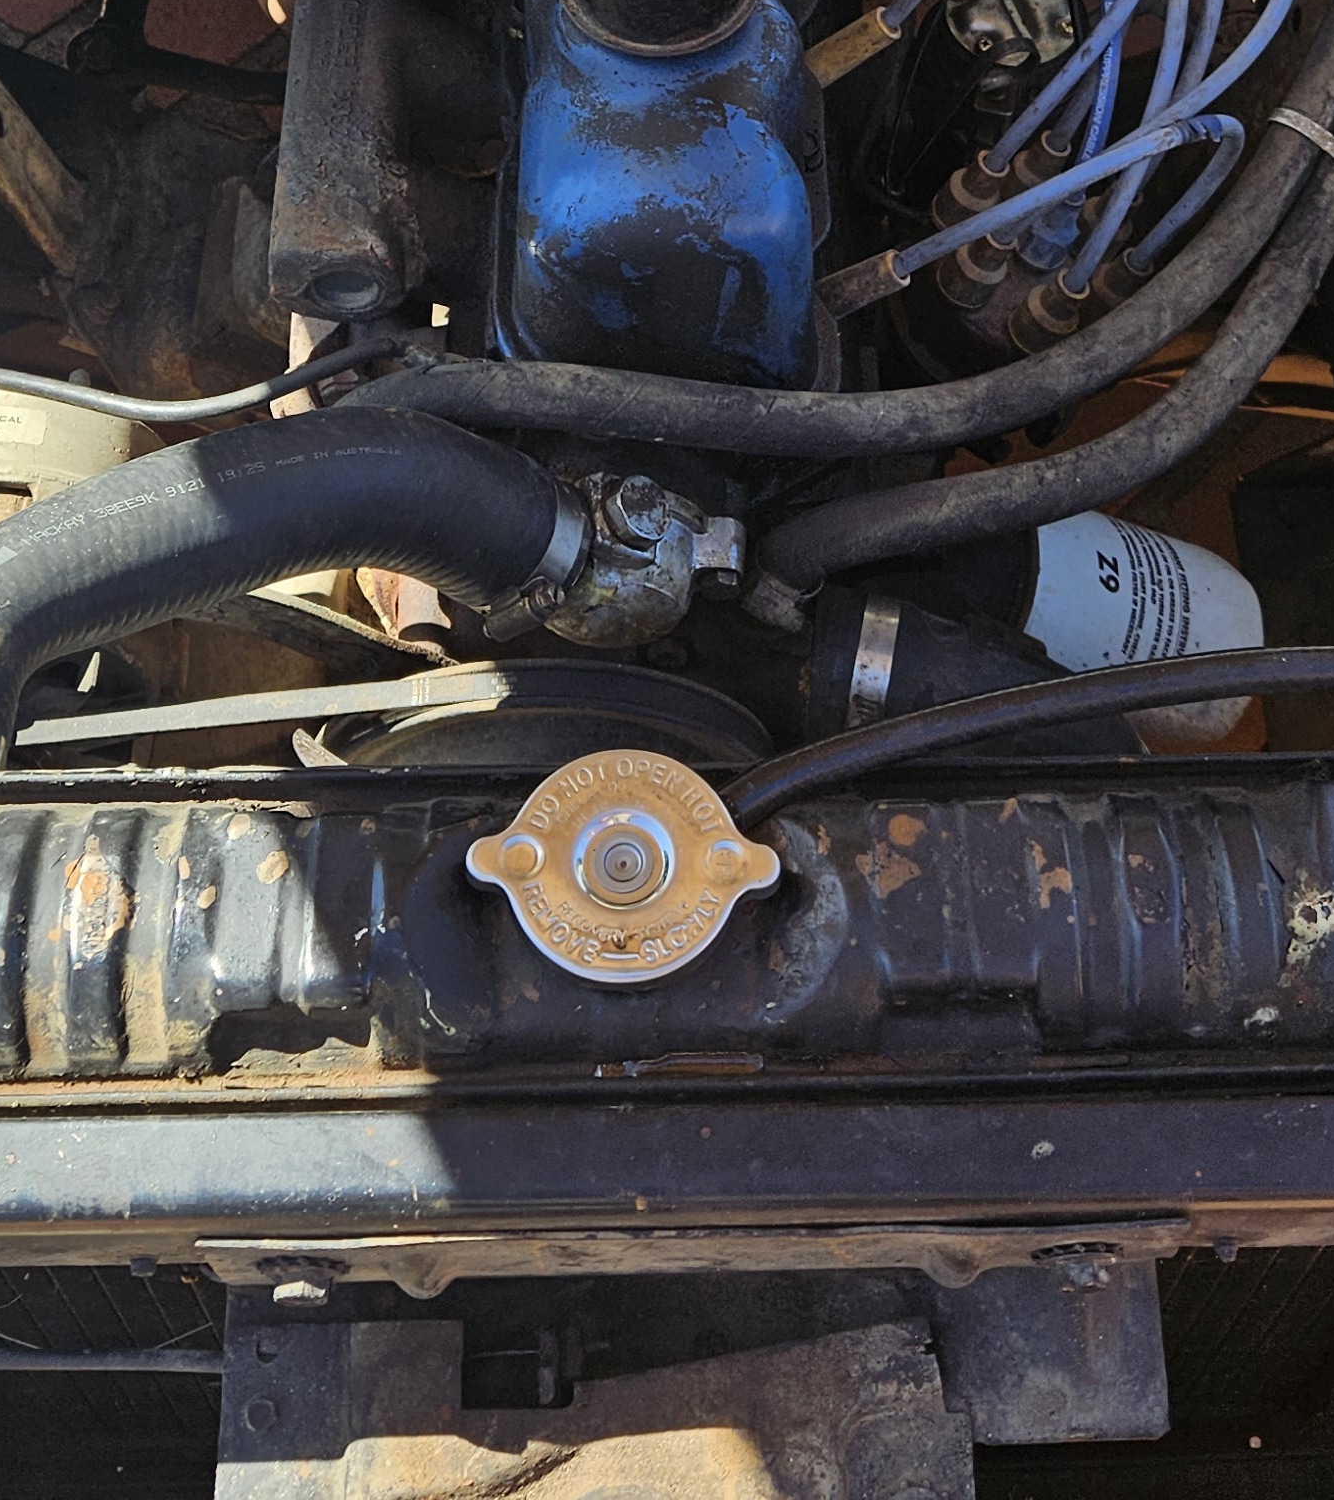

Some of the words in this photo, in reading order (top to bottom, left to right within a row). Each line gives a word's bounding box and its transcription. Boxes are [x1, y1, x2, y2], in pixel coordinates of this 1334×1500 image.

[1092, 46, 1114, 125] SUPPRESSION
[22, 509, 88, 547] MACKAY
[163, 476, 207, 499] 9121
[1096, 550, 1121, 593] Z9
[1131, 571, 1140, 597] FILTER
[1150, 587, 1158, 605] PAD
[1168, 591, 1177, 624] GREASE
[1177, 572, 1191, 614] FITTING
[1121, 607, 1138, 656] NECESSARY
[1153, 616, 1164, 643] AFTER
[529, 794, 561, 831] DO
[557, 762, 606, 799] NOT
[616, 758, 685, 797] OPEN
[679, 786, 725, 834] HOT
[521, 881, 602, 964] REMOVE
[557, 900, 627, 942] RECOVERY
